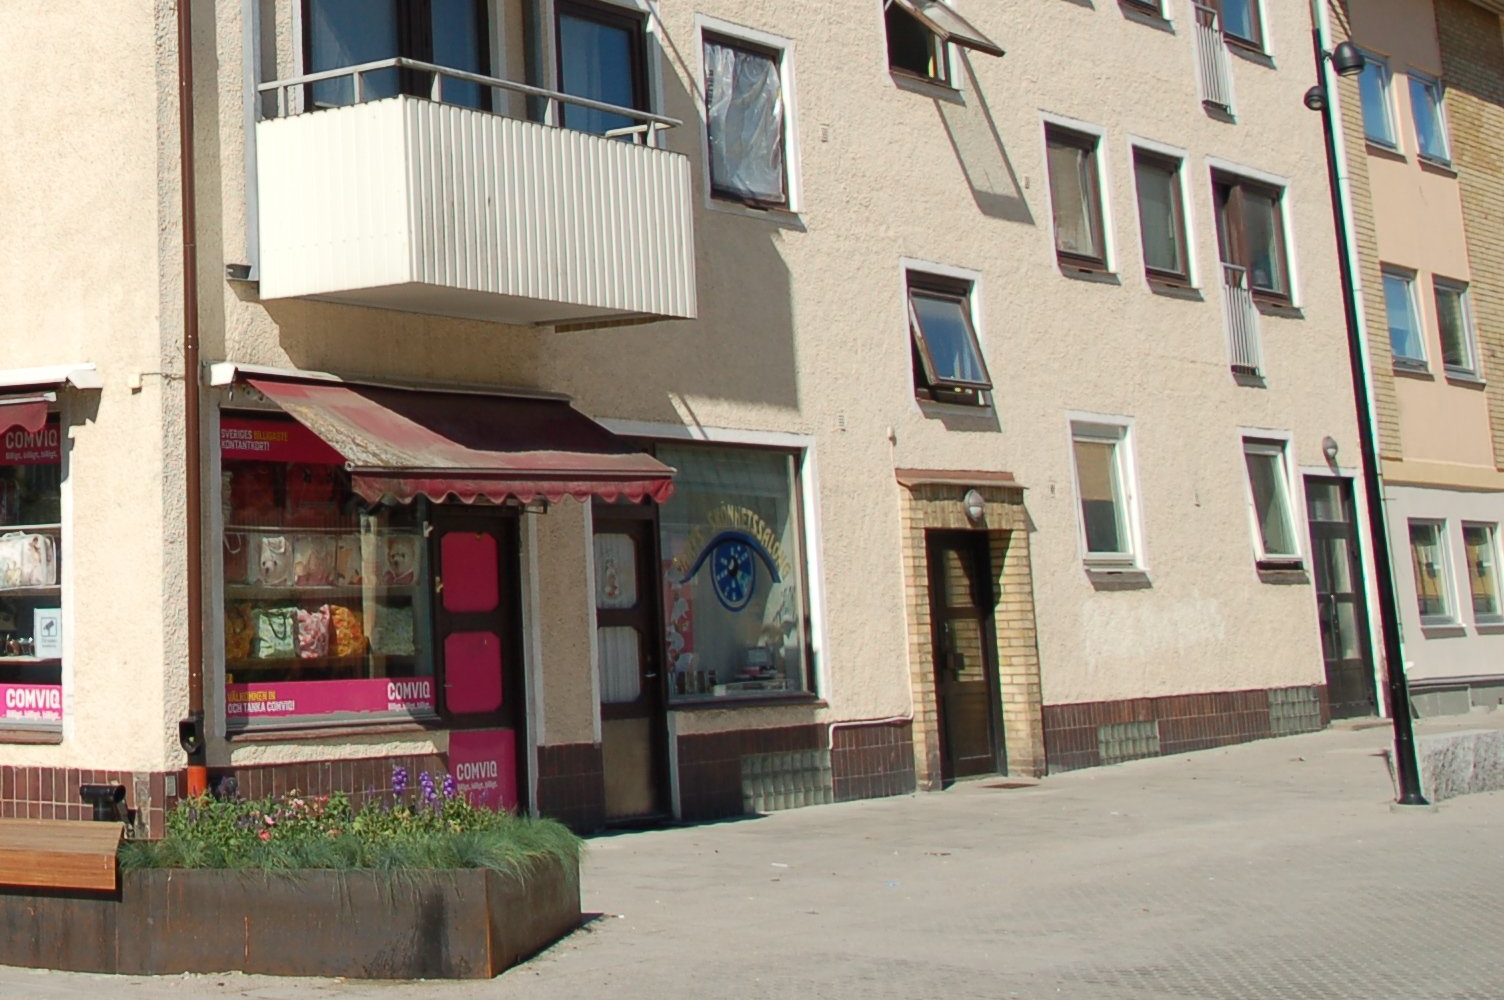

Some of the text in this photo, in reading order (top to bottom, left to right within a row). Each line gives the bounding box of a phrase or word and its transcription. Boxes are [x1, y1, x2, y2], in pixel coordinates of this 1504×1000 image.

[5, 428, 58, 449] COMVIQ
[221, 428, 252, 440] SVERIGES
[5, 687, 61, 710] COMVIQ
[386, 681, 431, 701] COMVIQ
[456, 760, 498, 781] COMVIQ
